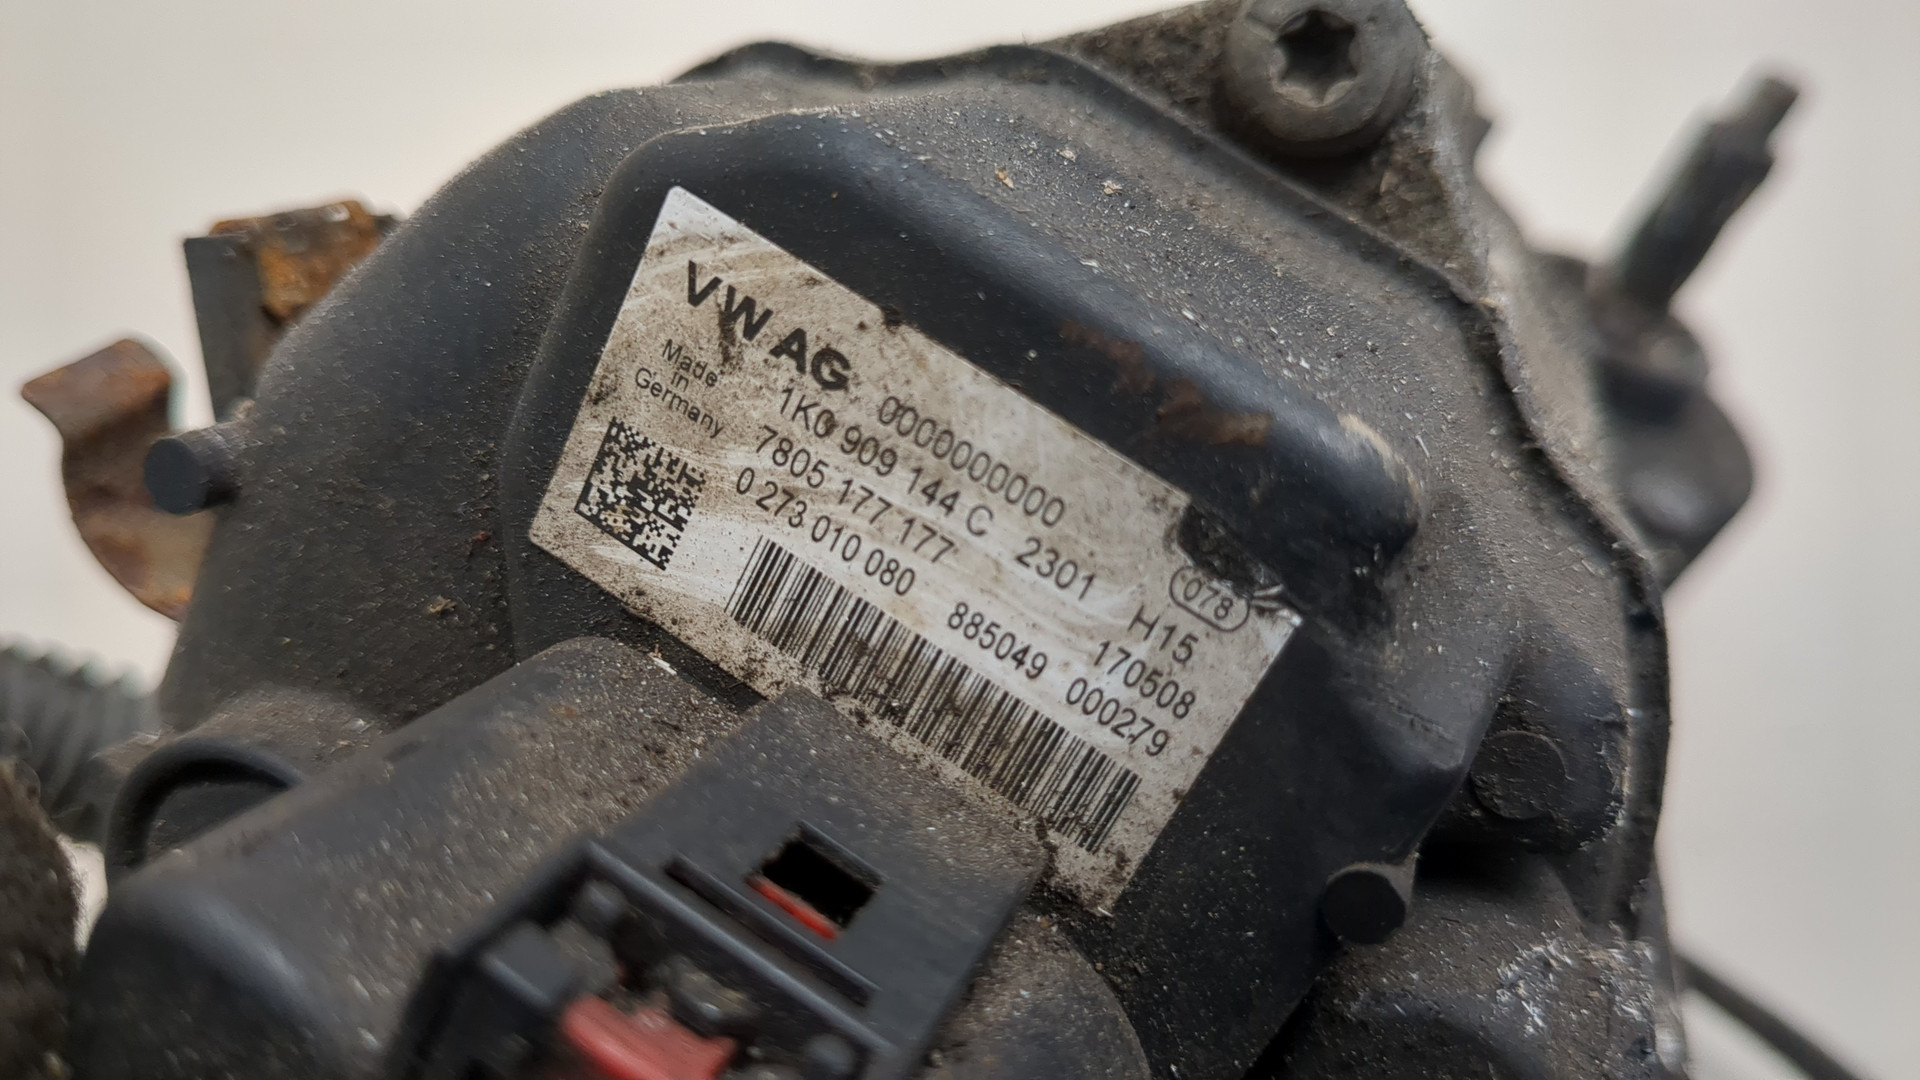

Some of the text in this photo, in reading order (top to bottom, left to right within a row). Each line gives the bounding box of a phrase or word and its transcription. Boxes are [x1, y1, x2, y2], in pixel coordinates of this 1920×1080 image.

[661, 338, 719, 388] Made
[671, 368, 690, 392] in
[686, 259, 851, 391] VW AG
[634, 367, 726, 439] Germany
[876, 395, 1066, 528] 0000000000
[754, 425, 1197, 720] 7805 177 177 170508
[778, 386, 1199, 665] 1K0 909 144 C 2301 H15
[736, 466, 1169, 758] 0 273 010 080 885049 000279
[1183, 576, 1235, 623] 078
